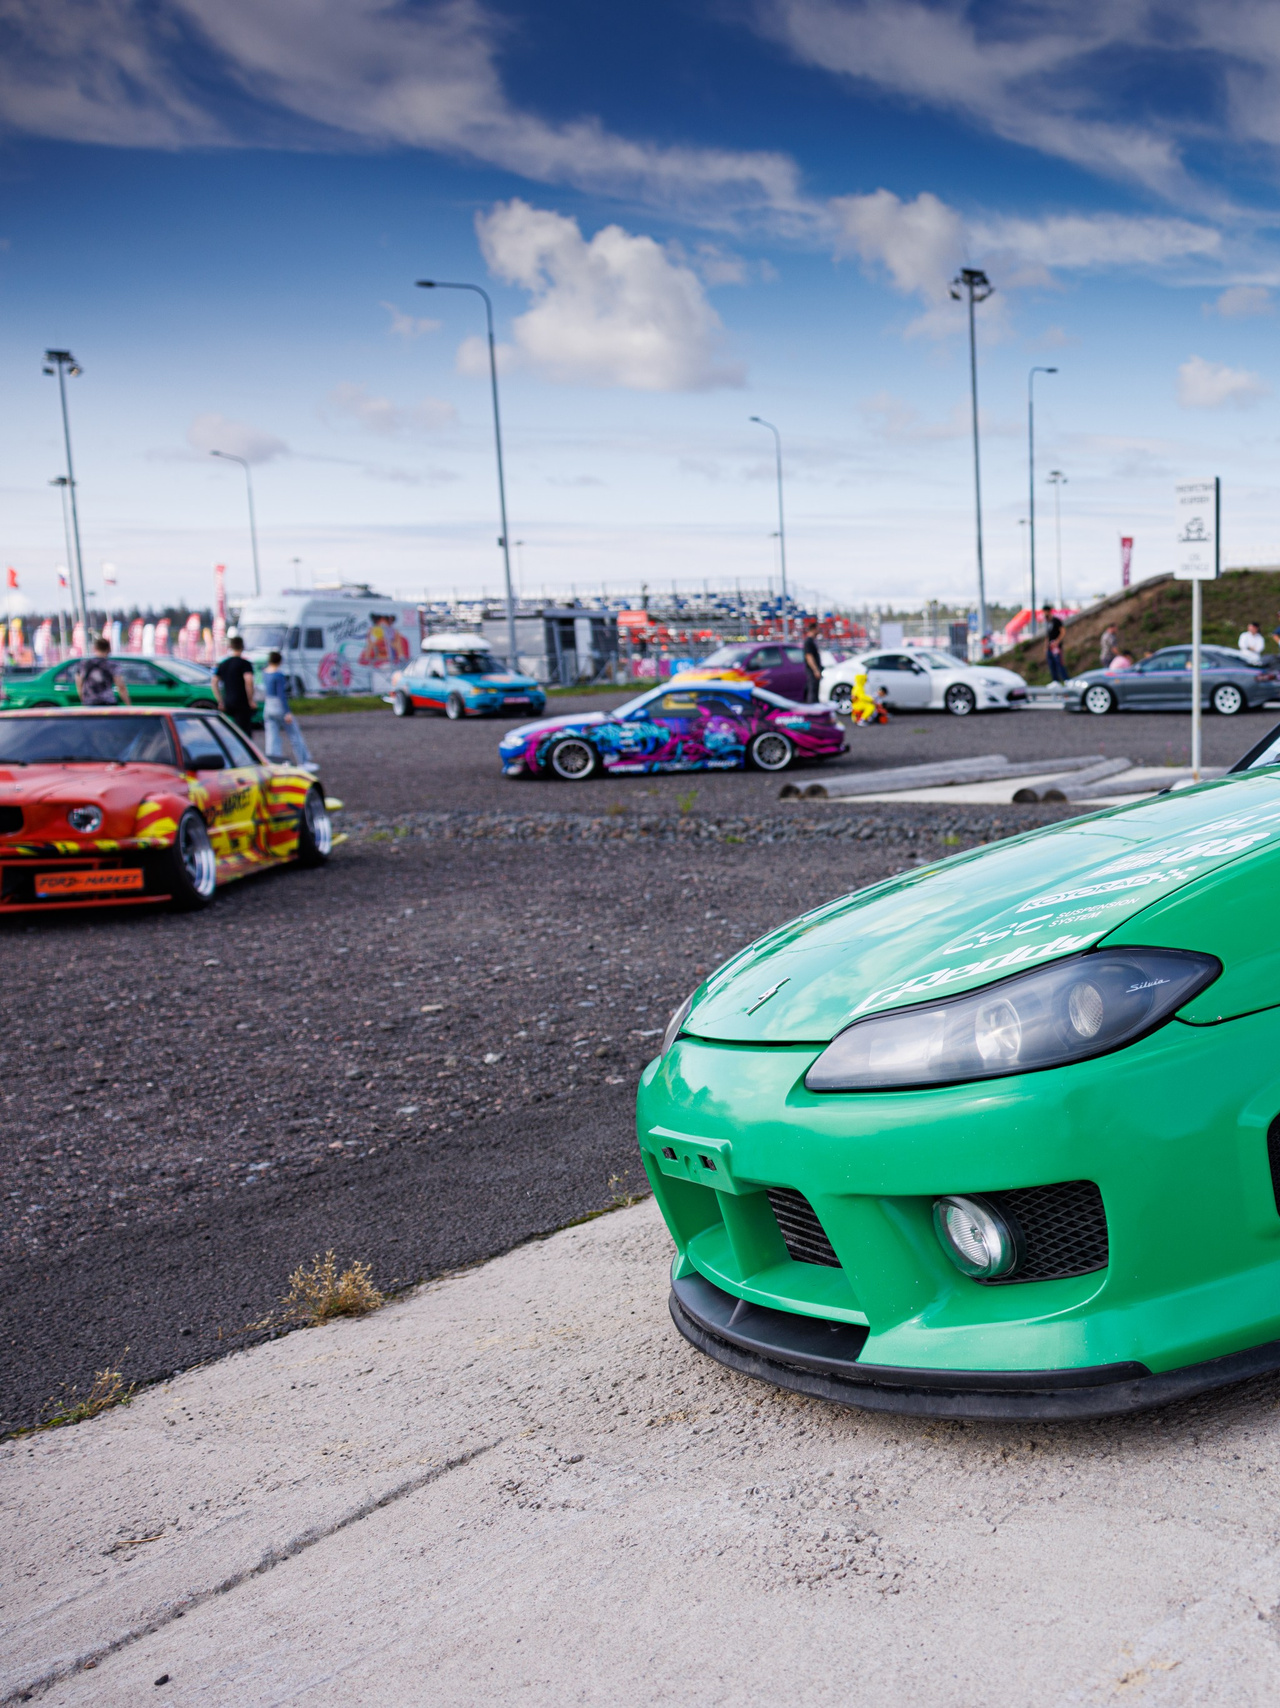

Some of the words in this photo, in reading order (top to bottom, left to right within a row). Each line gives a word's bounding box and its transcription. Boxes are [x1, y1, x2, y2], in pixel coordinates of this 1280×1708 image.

[1160, 833, 1271, 864] 88
[1020, 876, 1150, 911] KOYORAD
[1048, 911, 1103, 928] SYSTEM
[1056, 898, 1140, 919] SUSPENSION
[849, 930, 1108, 1017] GReddy
[1126, 976, 1170, 993] Silvia
